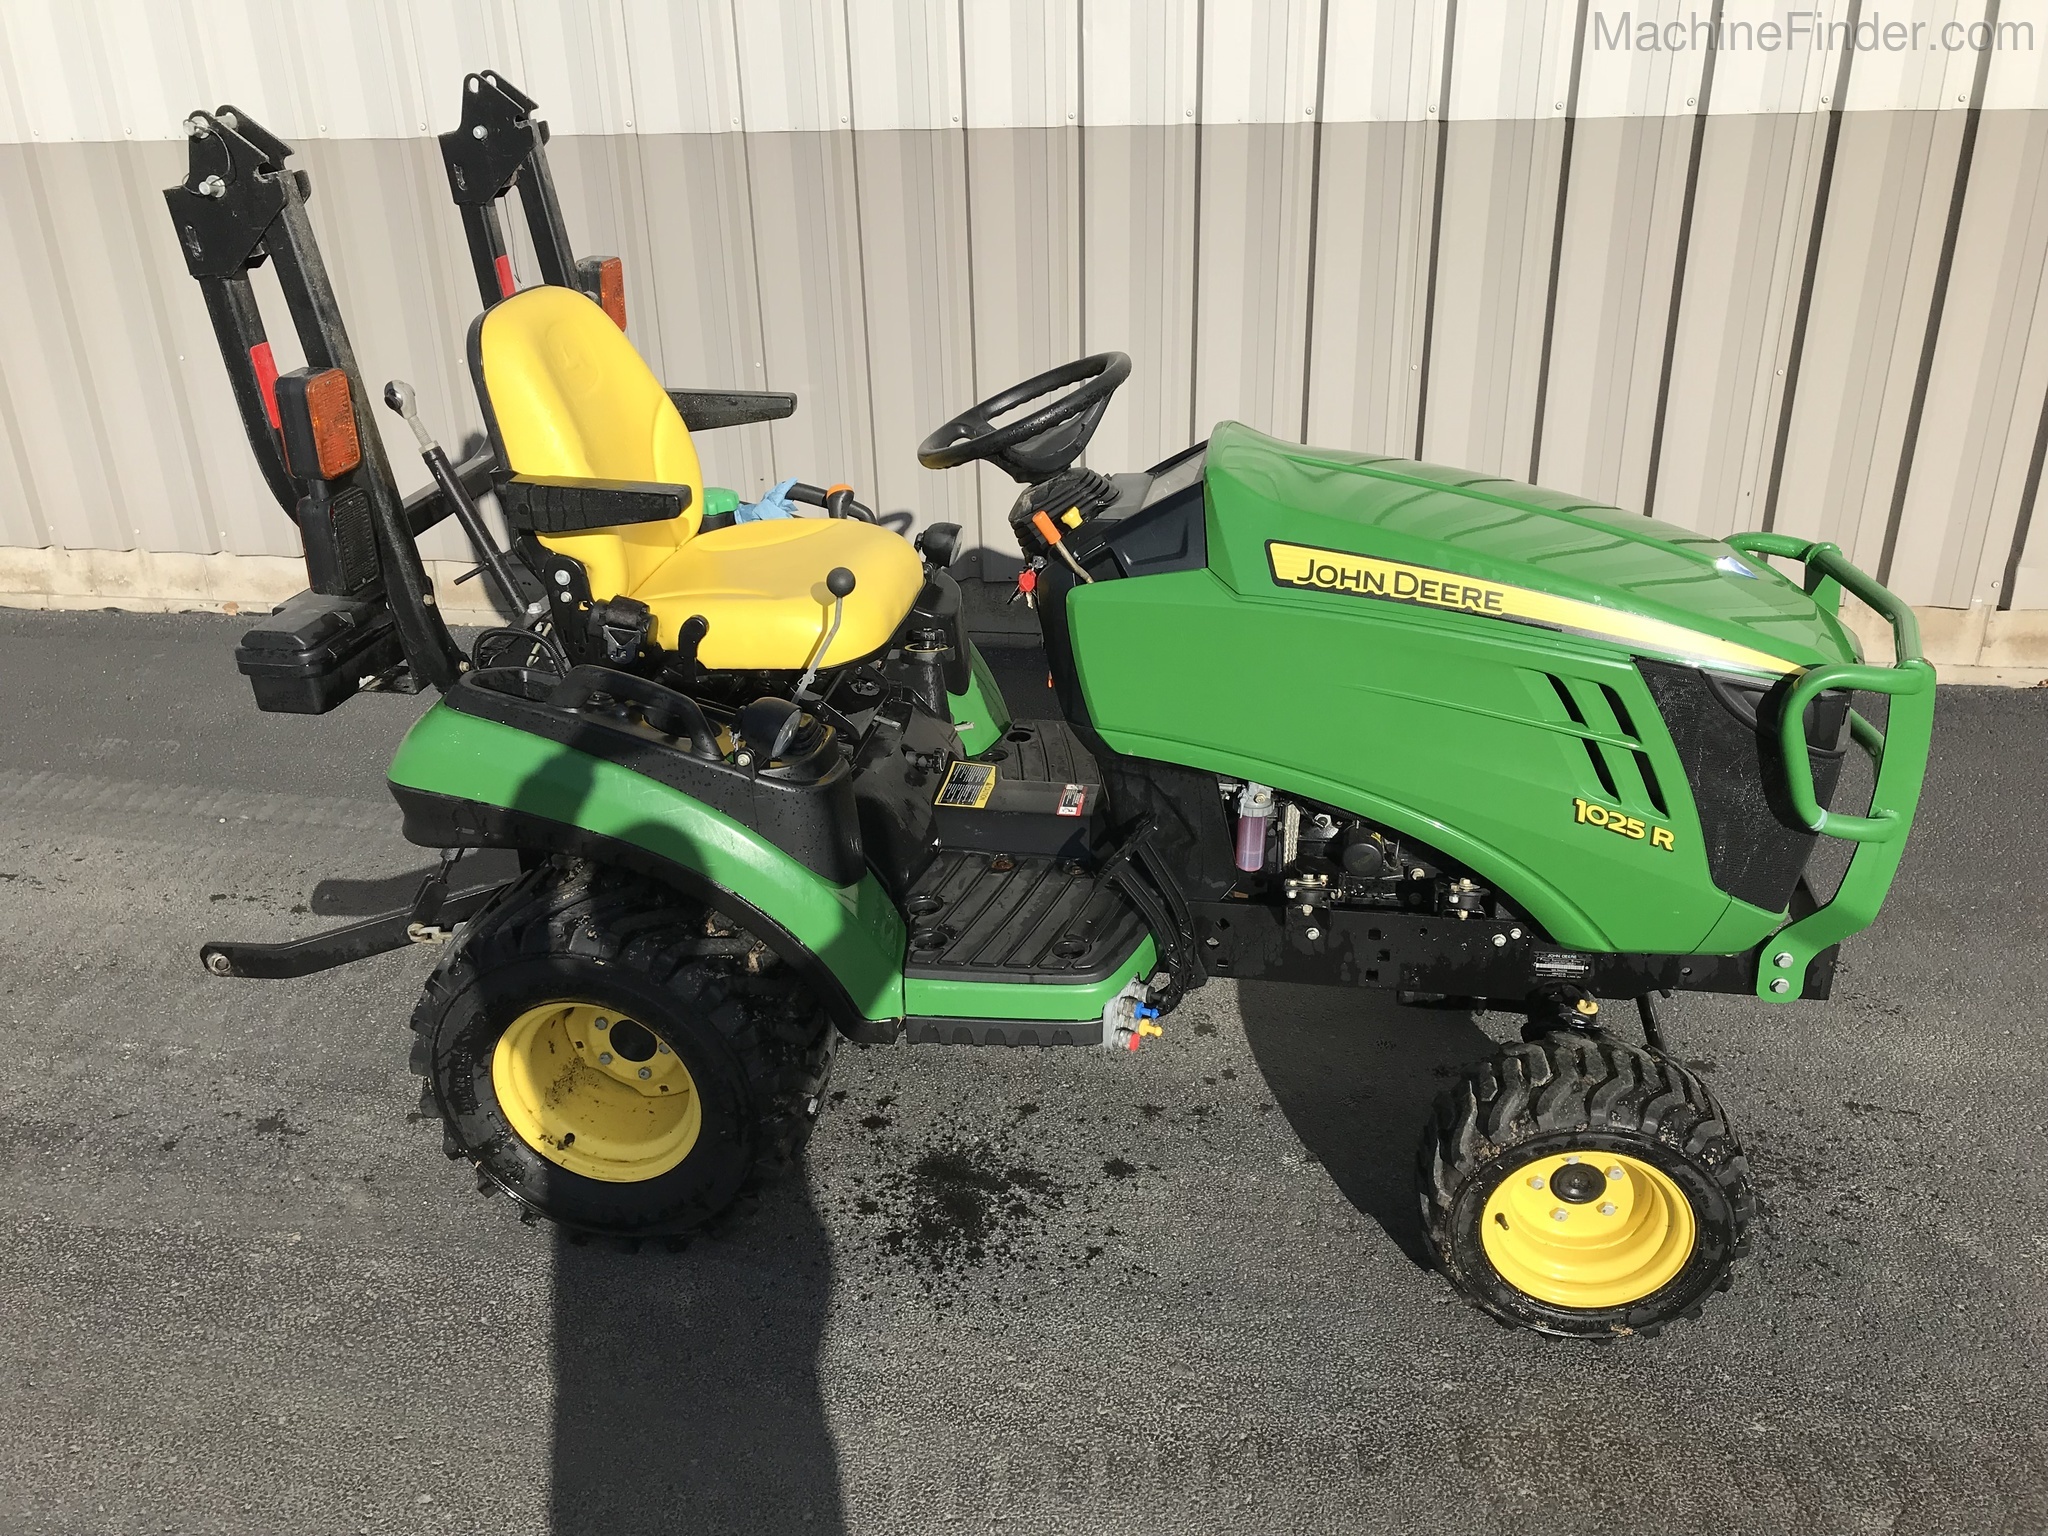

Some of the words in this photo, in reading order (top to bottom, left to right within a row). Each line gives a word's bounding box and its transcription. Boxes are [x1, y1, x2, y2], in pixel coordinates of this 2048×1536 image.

[1296, 558, 1385, 592] JOHN
[1393, 570, 1504, 612] DEERE
[1573, 797, 1646, 840] 1025
[1649, 825, 1675, 853] R
